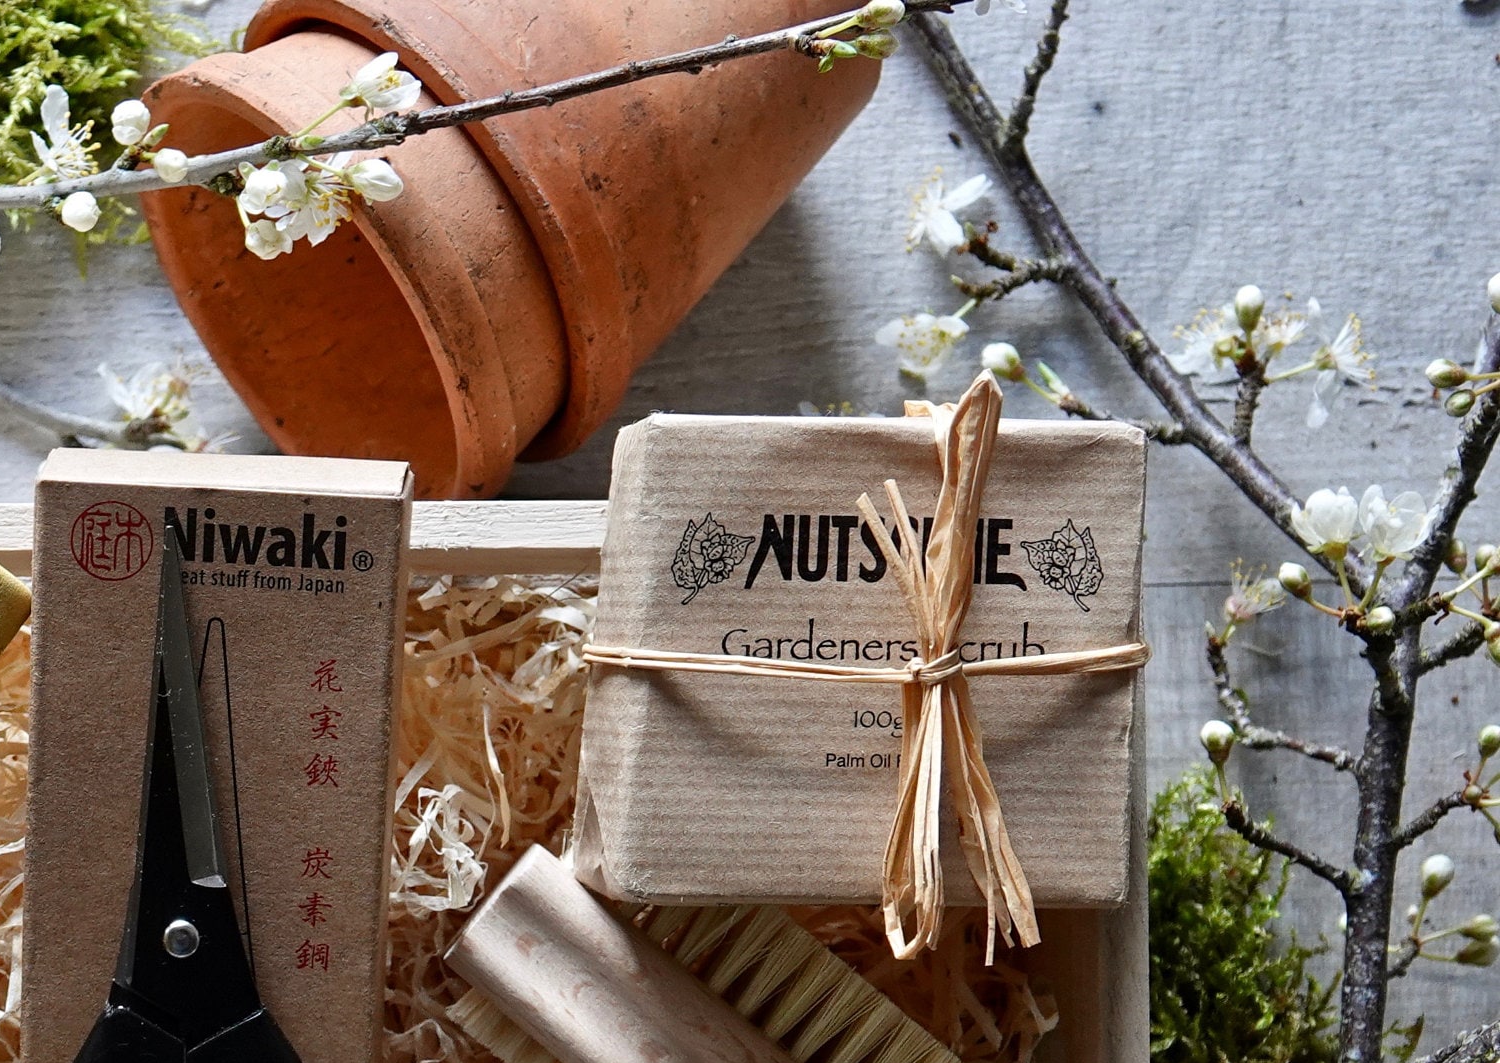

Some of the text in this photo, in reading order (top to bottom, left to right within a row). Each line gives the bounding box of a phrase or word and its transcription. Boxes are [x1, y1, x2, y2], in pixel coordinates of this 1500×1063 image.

[211, 570, 249, 588] stuff
[254, 571, 291, 590] from
[298, 574, 345, 596] Japan
[721, 618, 1046, 663] Gardeners crub
[825, 752, 865, 768] Palm
[870, 753, 891, 768] Oil
